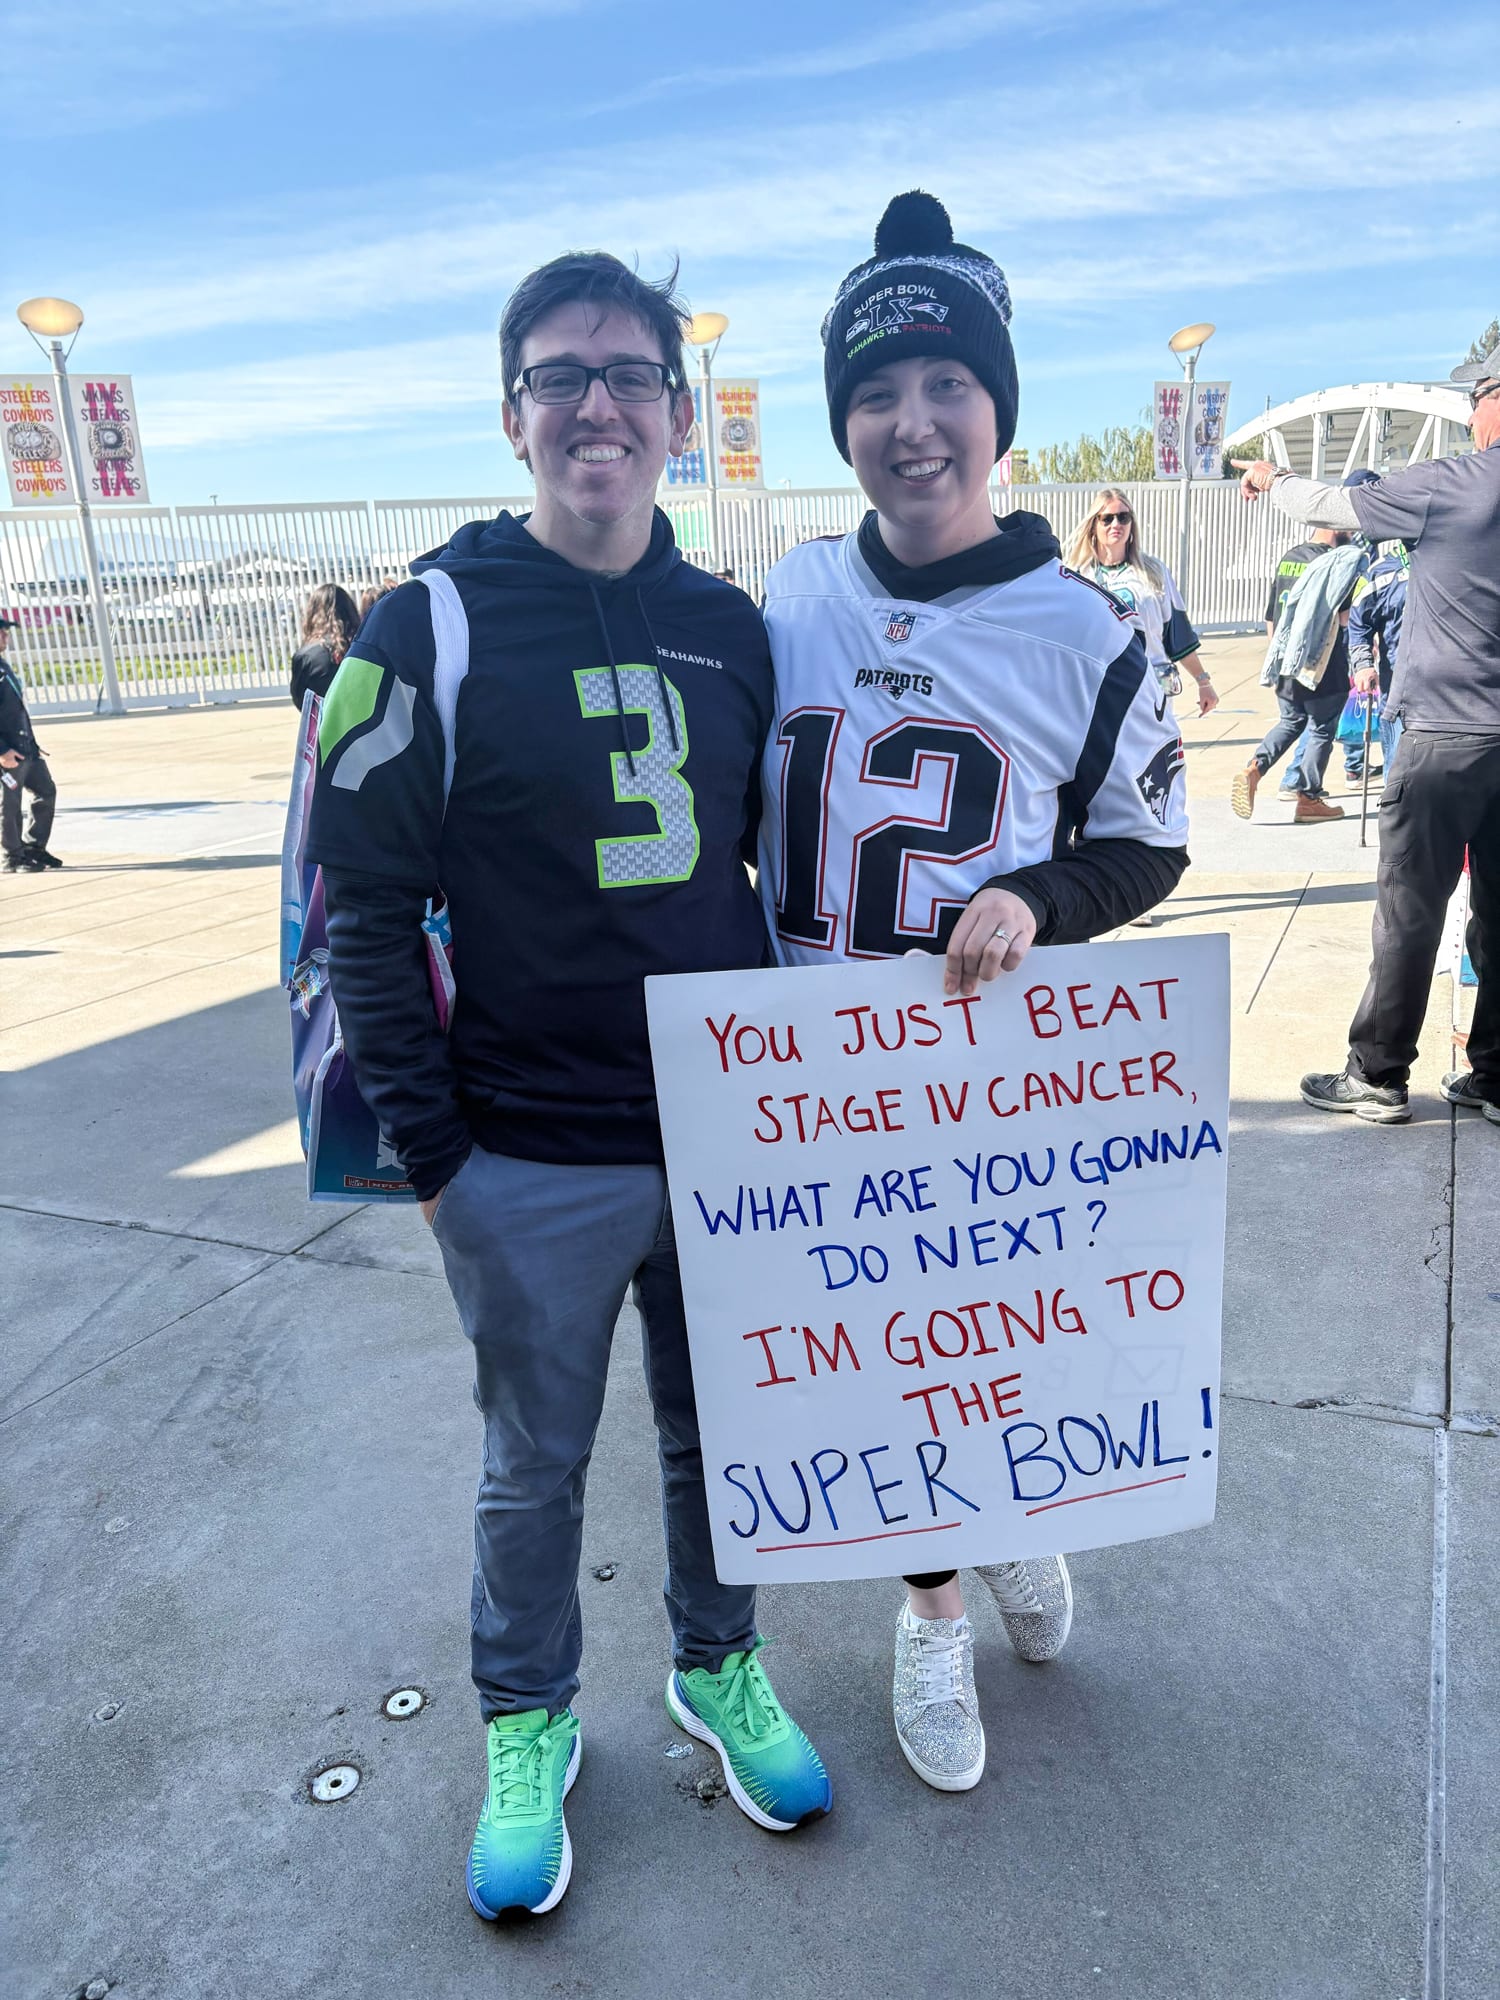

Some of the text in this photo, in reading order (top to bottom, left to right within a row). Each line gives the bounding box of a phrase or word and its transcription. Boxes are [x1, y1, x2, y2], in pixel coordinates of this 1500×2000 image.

[853, 284, 938, 317] SUPER BOWL
[869, 297, 914, 332] LX
[886, 325, 902, 335] VS.
[902, 323, 952, 334] PATRIOTS
[0, 390, 50, 404] STEELERS
[3, 409, 54, 423] COWBOYS
[12, 461, 63, 473] STEELERS
[16, 478, 67, 492] COWBOYS
[887, 623, 908, 640] NFL
[854, 668, 934, 696] PATRIOTS
[573, 663, 700, 888] 3
[776, 706, 1010, 960] 12
[835, 996, 981, 1055] JUST
[1023, 978, 1179, 1039] BEAT
[754, 1050, 1198, 1143] STAGE IV CANCER,
[693, 1120, 1222, 1236] WHAT ARE YOU GONNA
[807, 1244, 888, 1291] DO
[742, 1269, 1185, 1387] I'M GOING TO
[902, 1373, 1024, 1437] THE
[723, 1387, 1213, 1538] SUPER BOWL!
